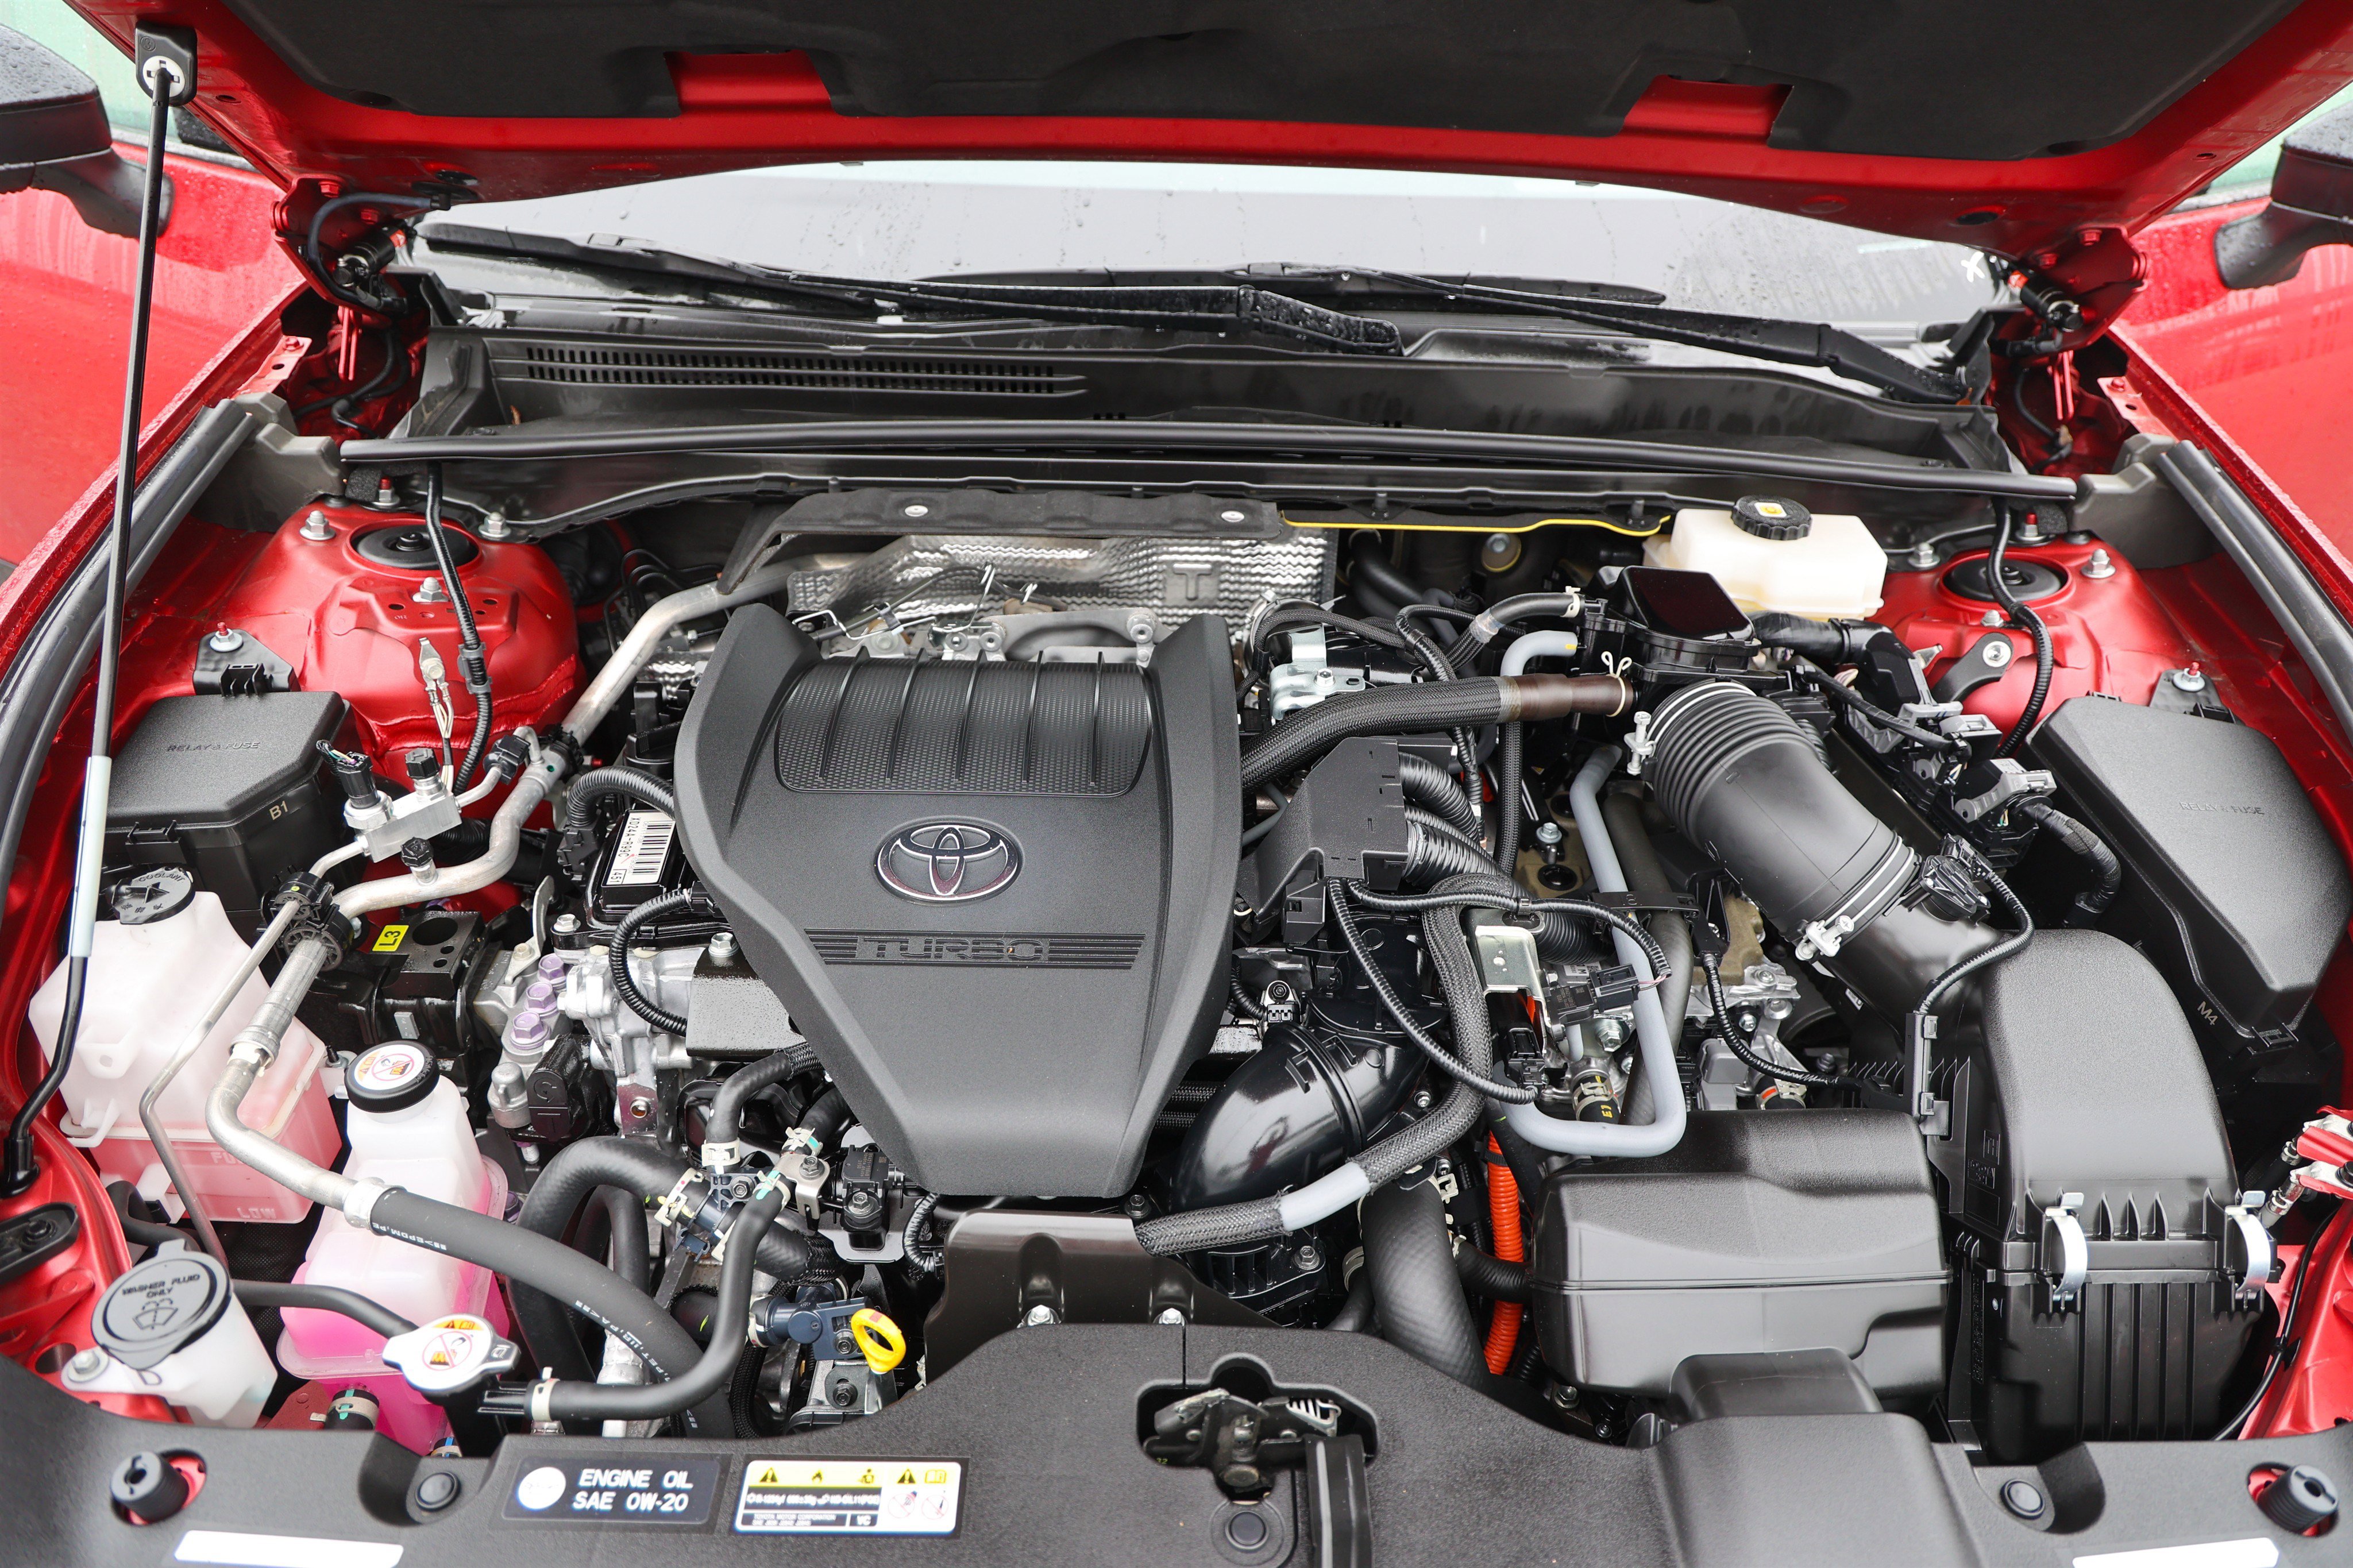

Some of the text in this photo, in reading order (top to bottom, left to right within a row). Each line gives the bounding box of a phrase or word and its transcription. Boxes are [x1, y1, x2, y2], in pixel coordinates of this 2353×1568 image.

[167, 744, 211, 752] RELAY
[226, 741, 260, 750] FUSE
[269, 800, 288, 821] B1
[2179, 802, 2219, 812] RELAY
[2231, 805, 2265, 815] FUSE
[139, 872, 186, 883] COOLANT
[610, 872, 623, 883] 451
[379, 930, 401, 947] L3
[863, 937, 1043, 959] TURBO
[2197, 1001, 2218, 1025] M4
[1600, 1104, 1613, 1118] E1
[237, 1207, 276, 1219] LOW
[122, 1274, 200, 1295] WASHER FLUID
[146, 1287, 173, 1298] ONLY
[578, 1468, 693, 1489] ENGINE OIL
[572, 1490, 689, 1511] SAE 0W-20
[857, 1515, 871, 1525] VC
